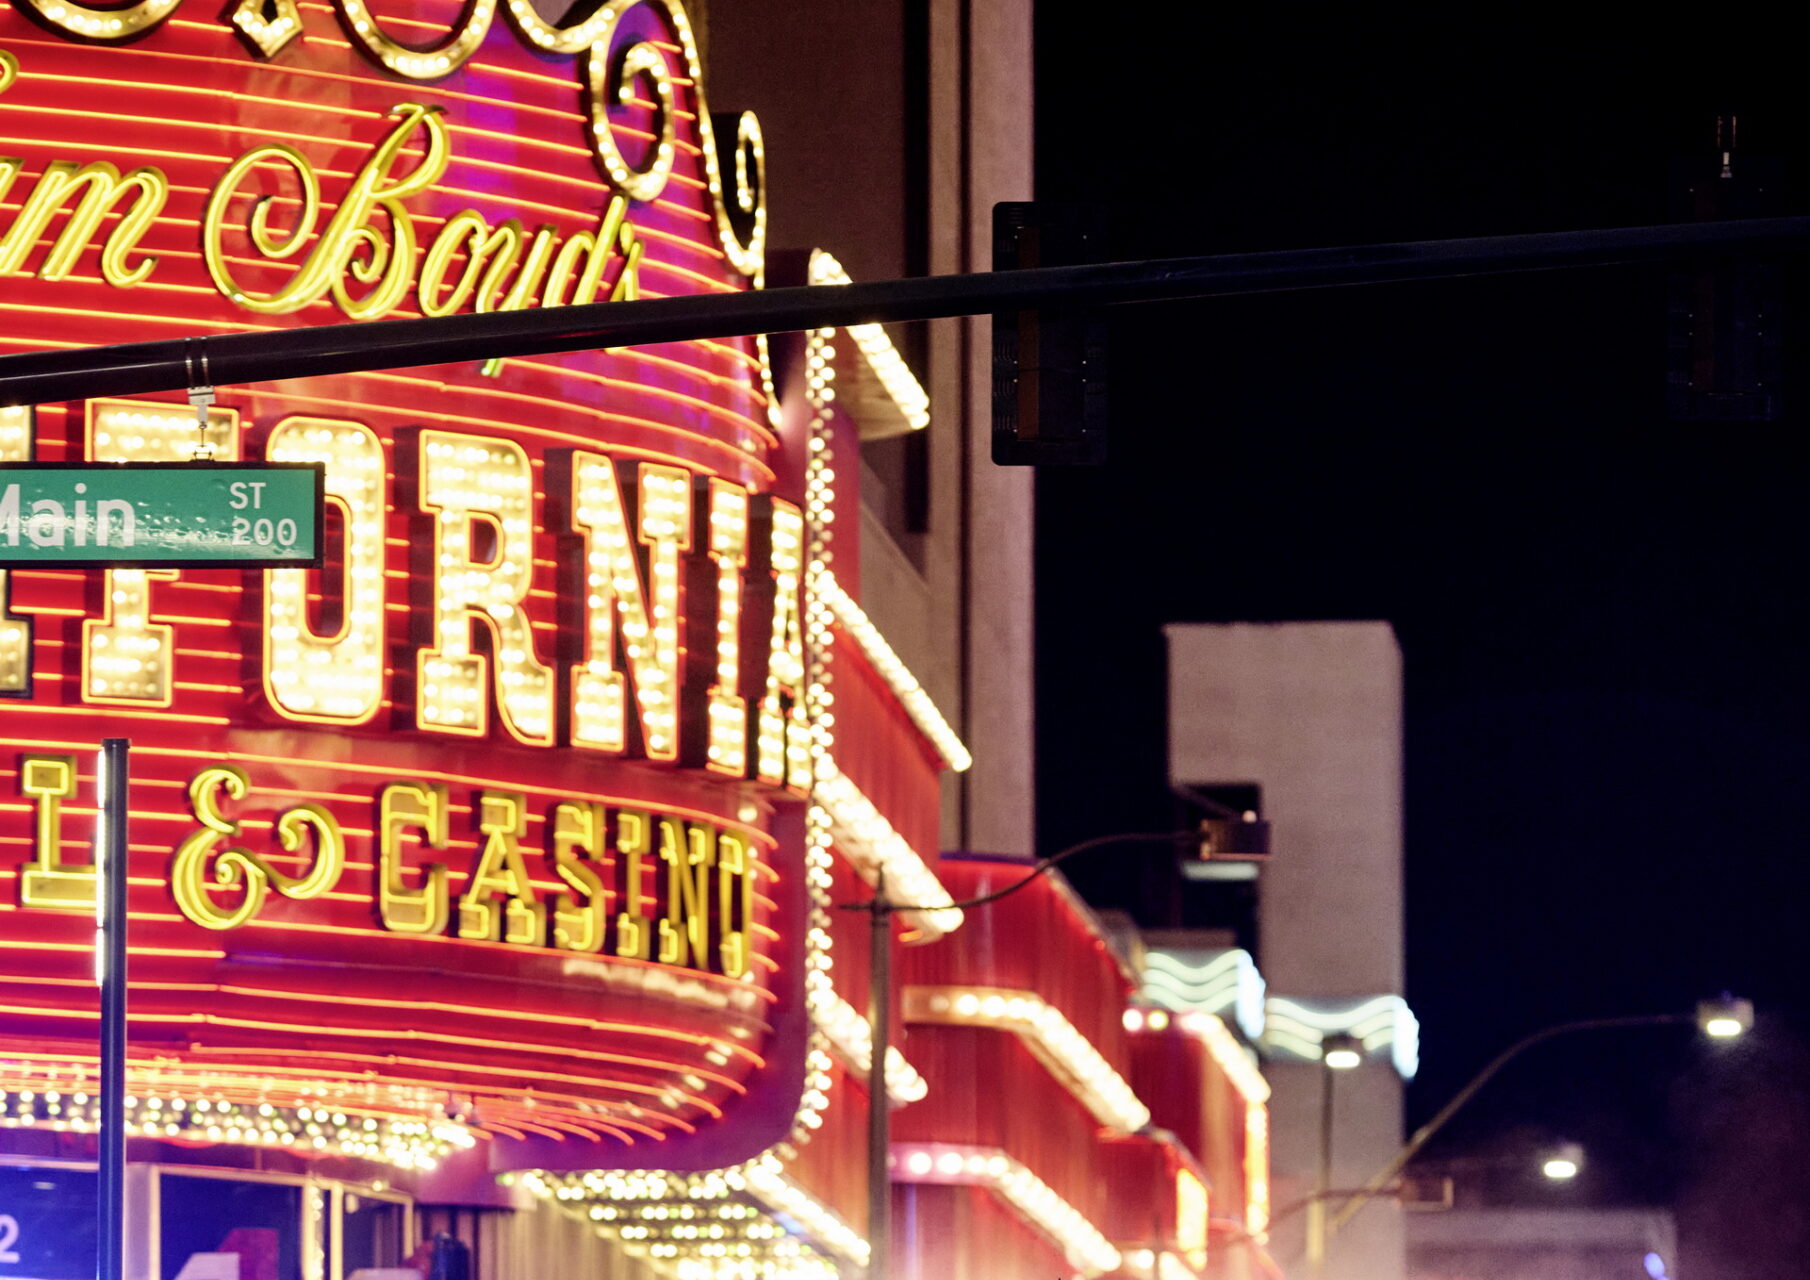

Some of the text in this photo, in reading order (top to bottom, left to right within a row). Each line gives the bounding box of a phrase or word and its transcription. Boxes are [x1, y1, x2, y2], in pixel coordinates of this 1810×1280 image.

[229, 481, 266, 509] ST
[231, 518, 297, 546] 200
[380, 781, 752, 979] CASINO
